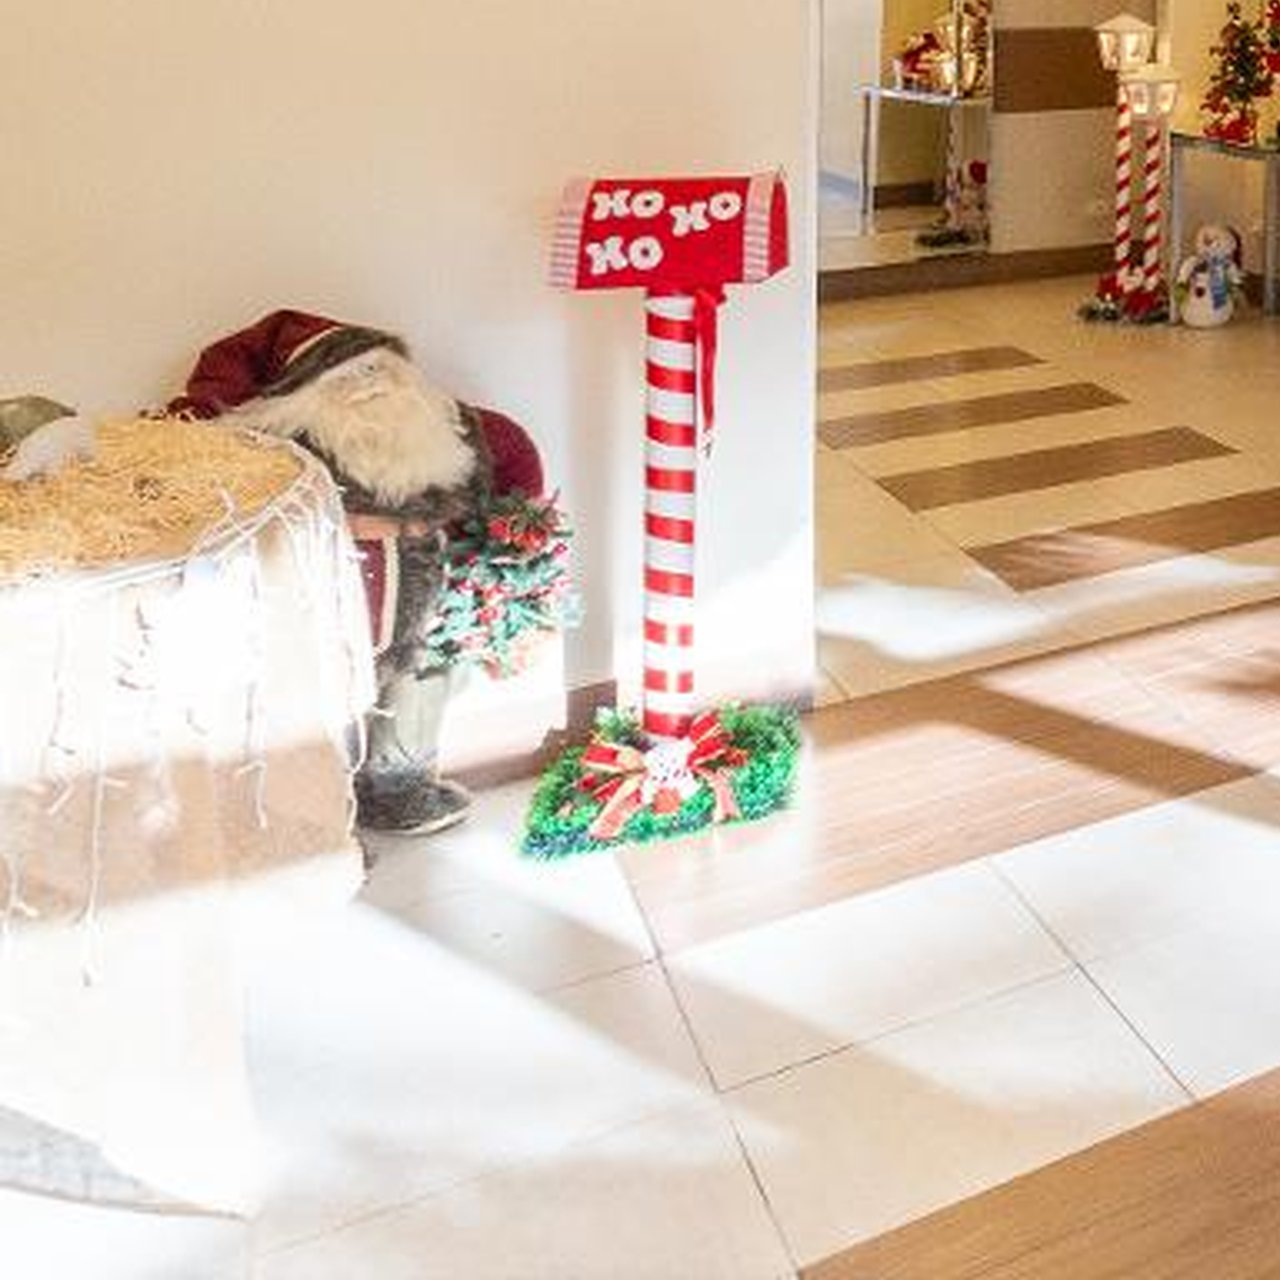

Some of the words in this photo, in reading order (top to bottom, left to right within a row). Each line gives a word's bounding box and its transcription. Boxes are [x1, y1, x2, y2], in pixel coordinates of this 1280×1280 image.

[592, 190, 664, 221] HO
[669, 191, 742, 237] HO
[585, 235, 664, 275] HO
